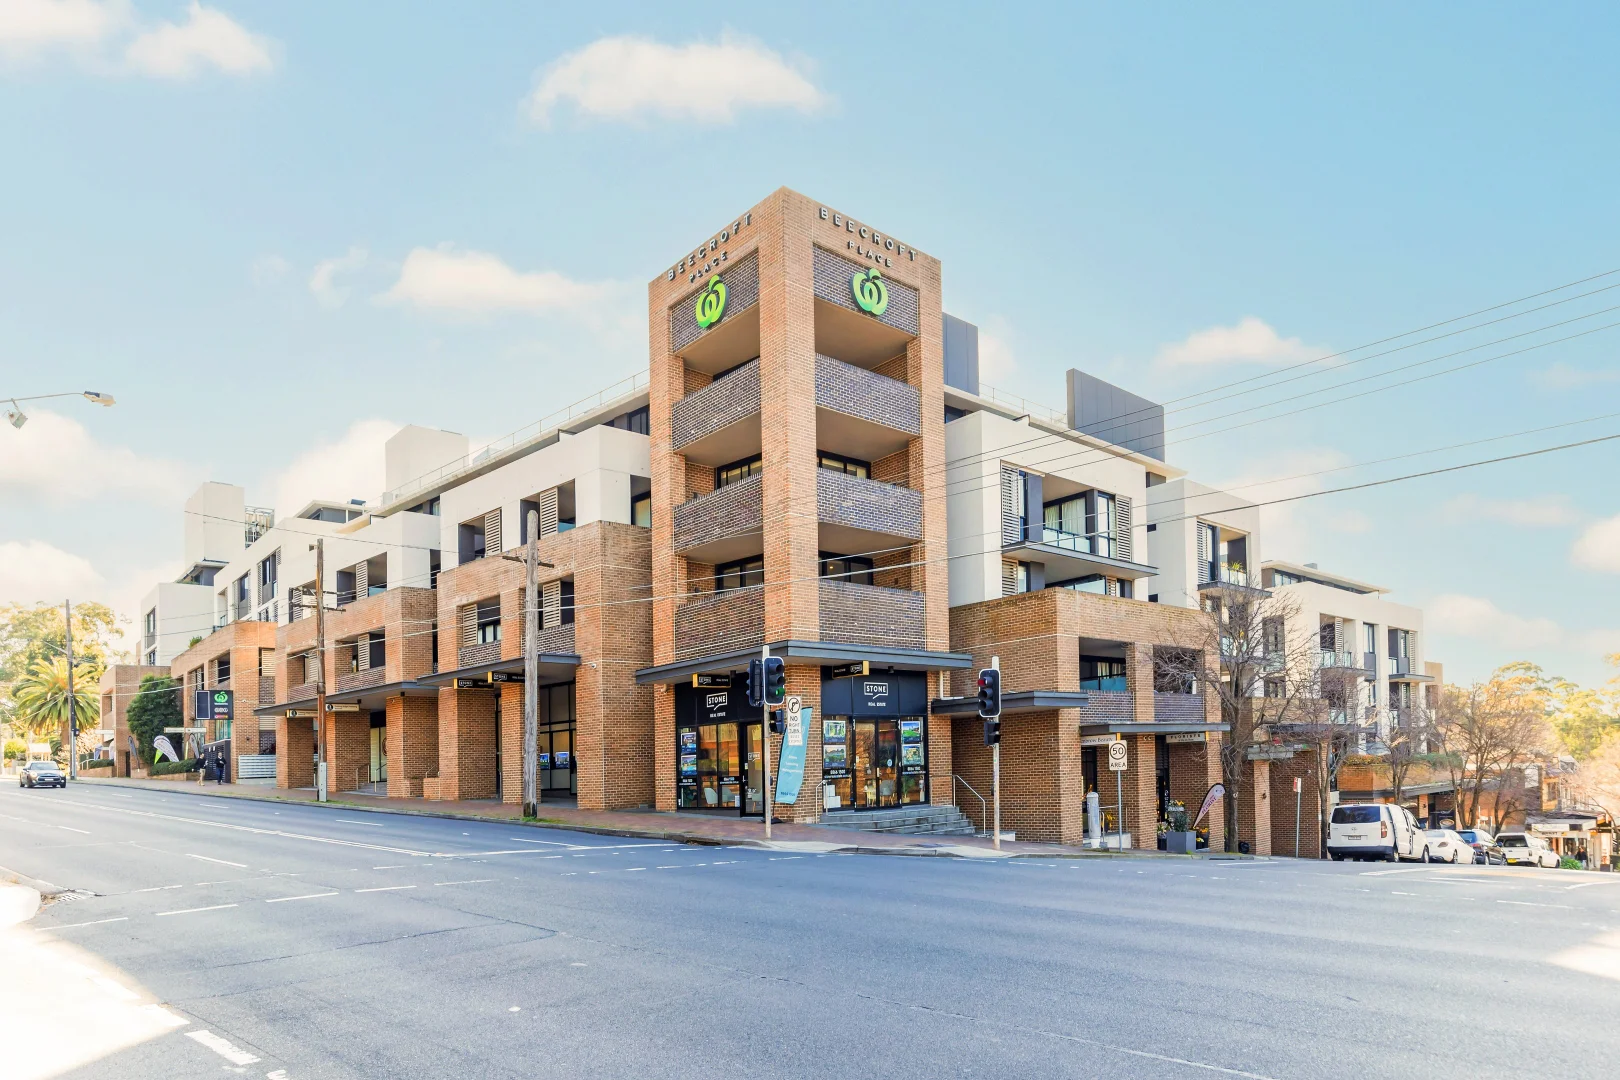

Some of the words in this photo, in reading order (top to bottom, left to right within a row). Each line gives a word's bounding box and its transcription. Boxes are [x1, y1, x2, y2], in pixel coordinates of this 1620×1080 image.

[667, 212, 753, 281] BEECROFT
[819, 207, 918, 261] BEECROFT
[688, 250, 729, 283] PLACE
[848, 240, 893, 267] PLACE
[708, 695, 726, 705] STONE
[866, 685, 887, 693] STONE
[1112, 747, 1124, 756] 50
